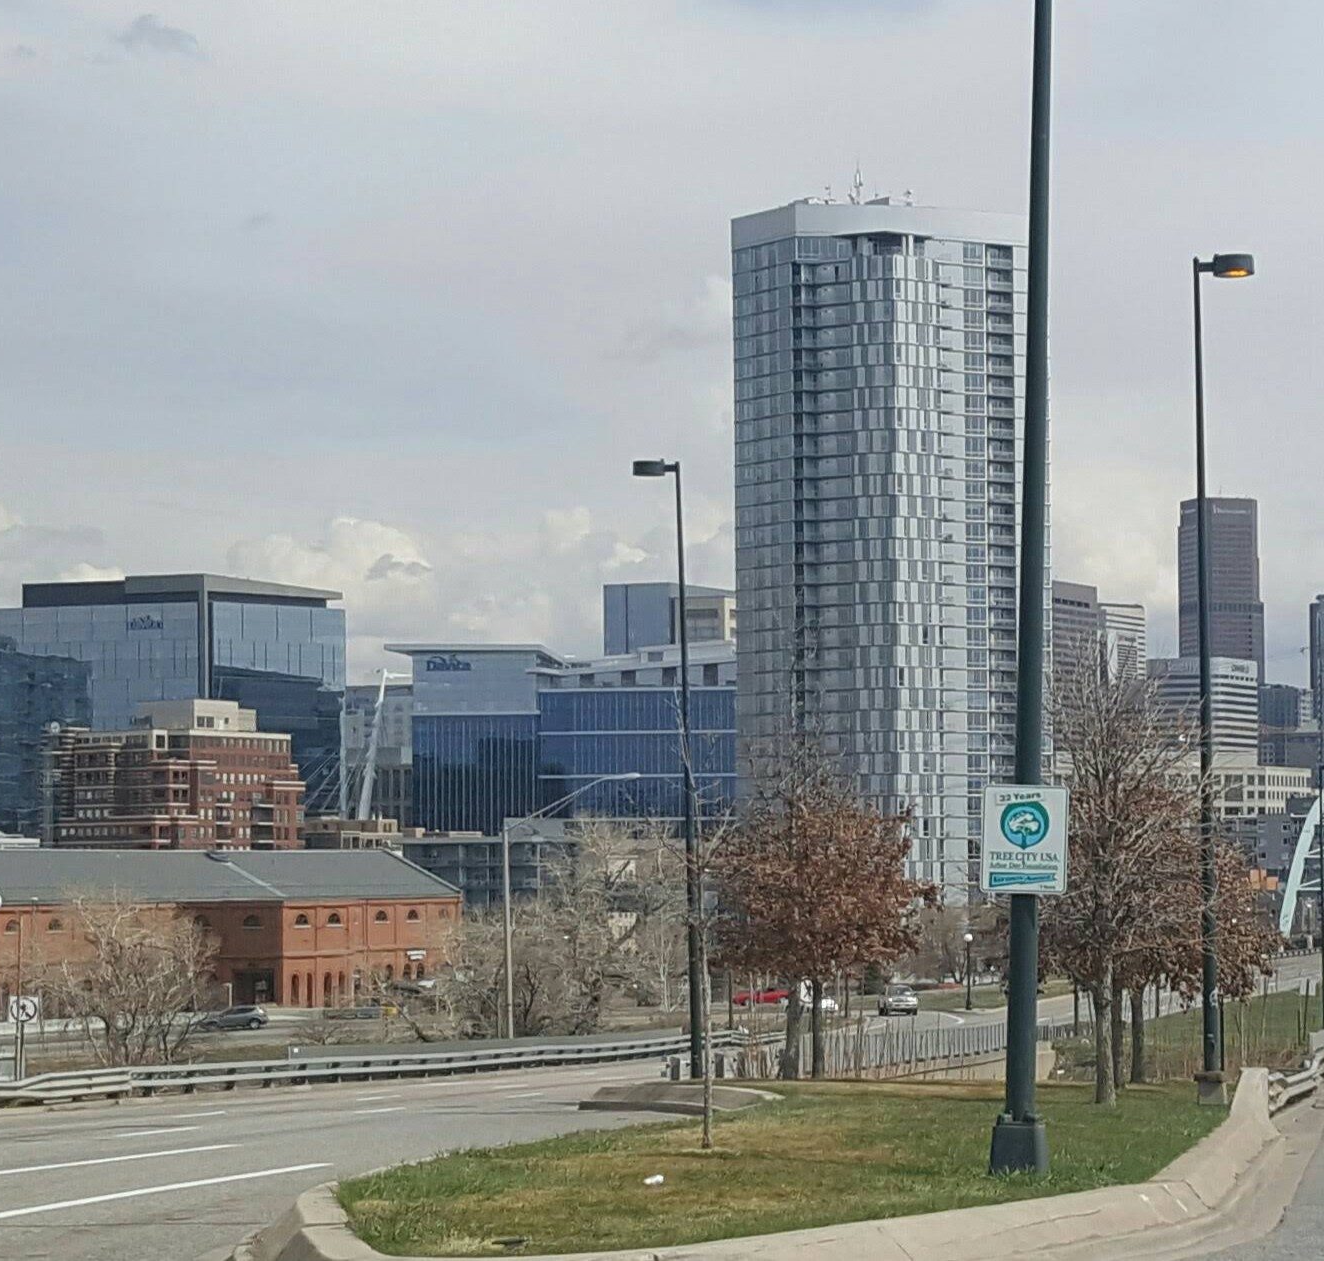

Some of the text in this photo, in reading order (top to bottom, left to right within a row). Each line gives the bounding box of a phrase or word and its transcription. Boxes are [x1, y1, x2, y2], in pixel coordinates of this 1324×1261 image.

[1013, 792, 1041, 800] Years
[989, 851, 1059, 862] TREE CITY USA
